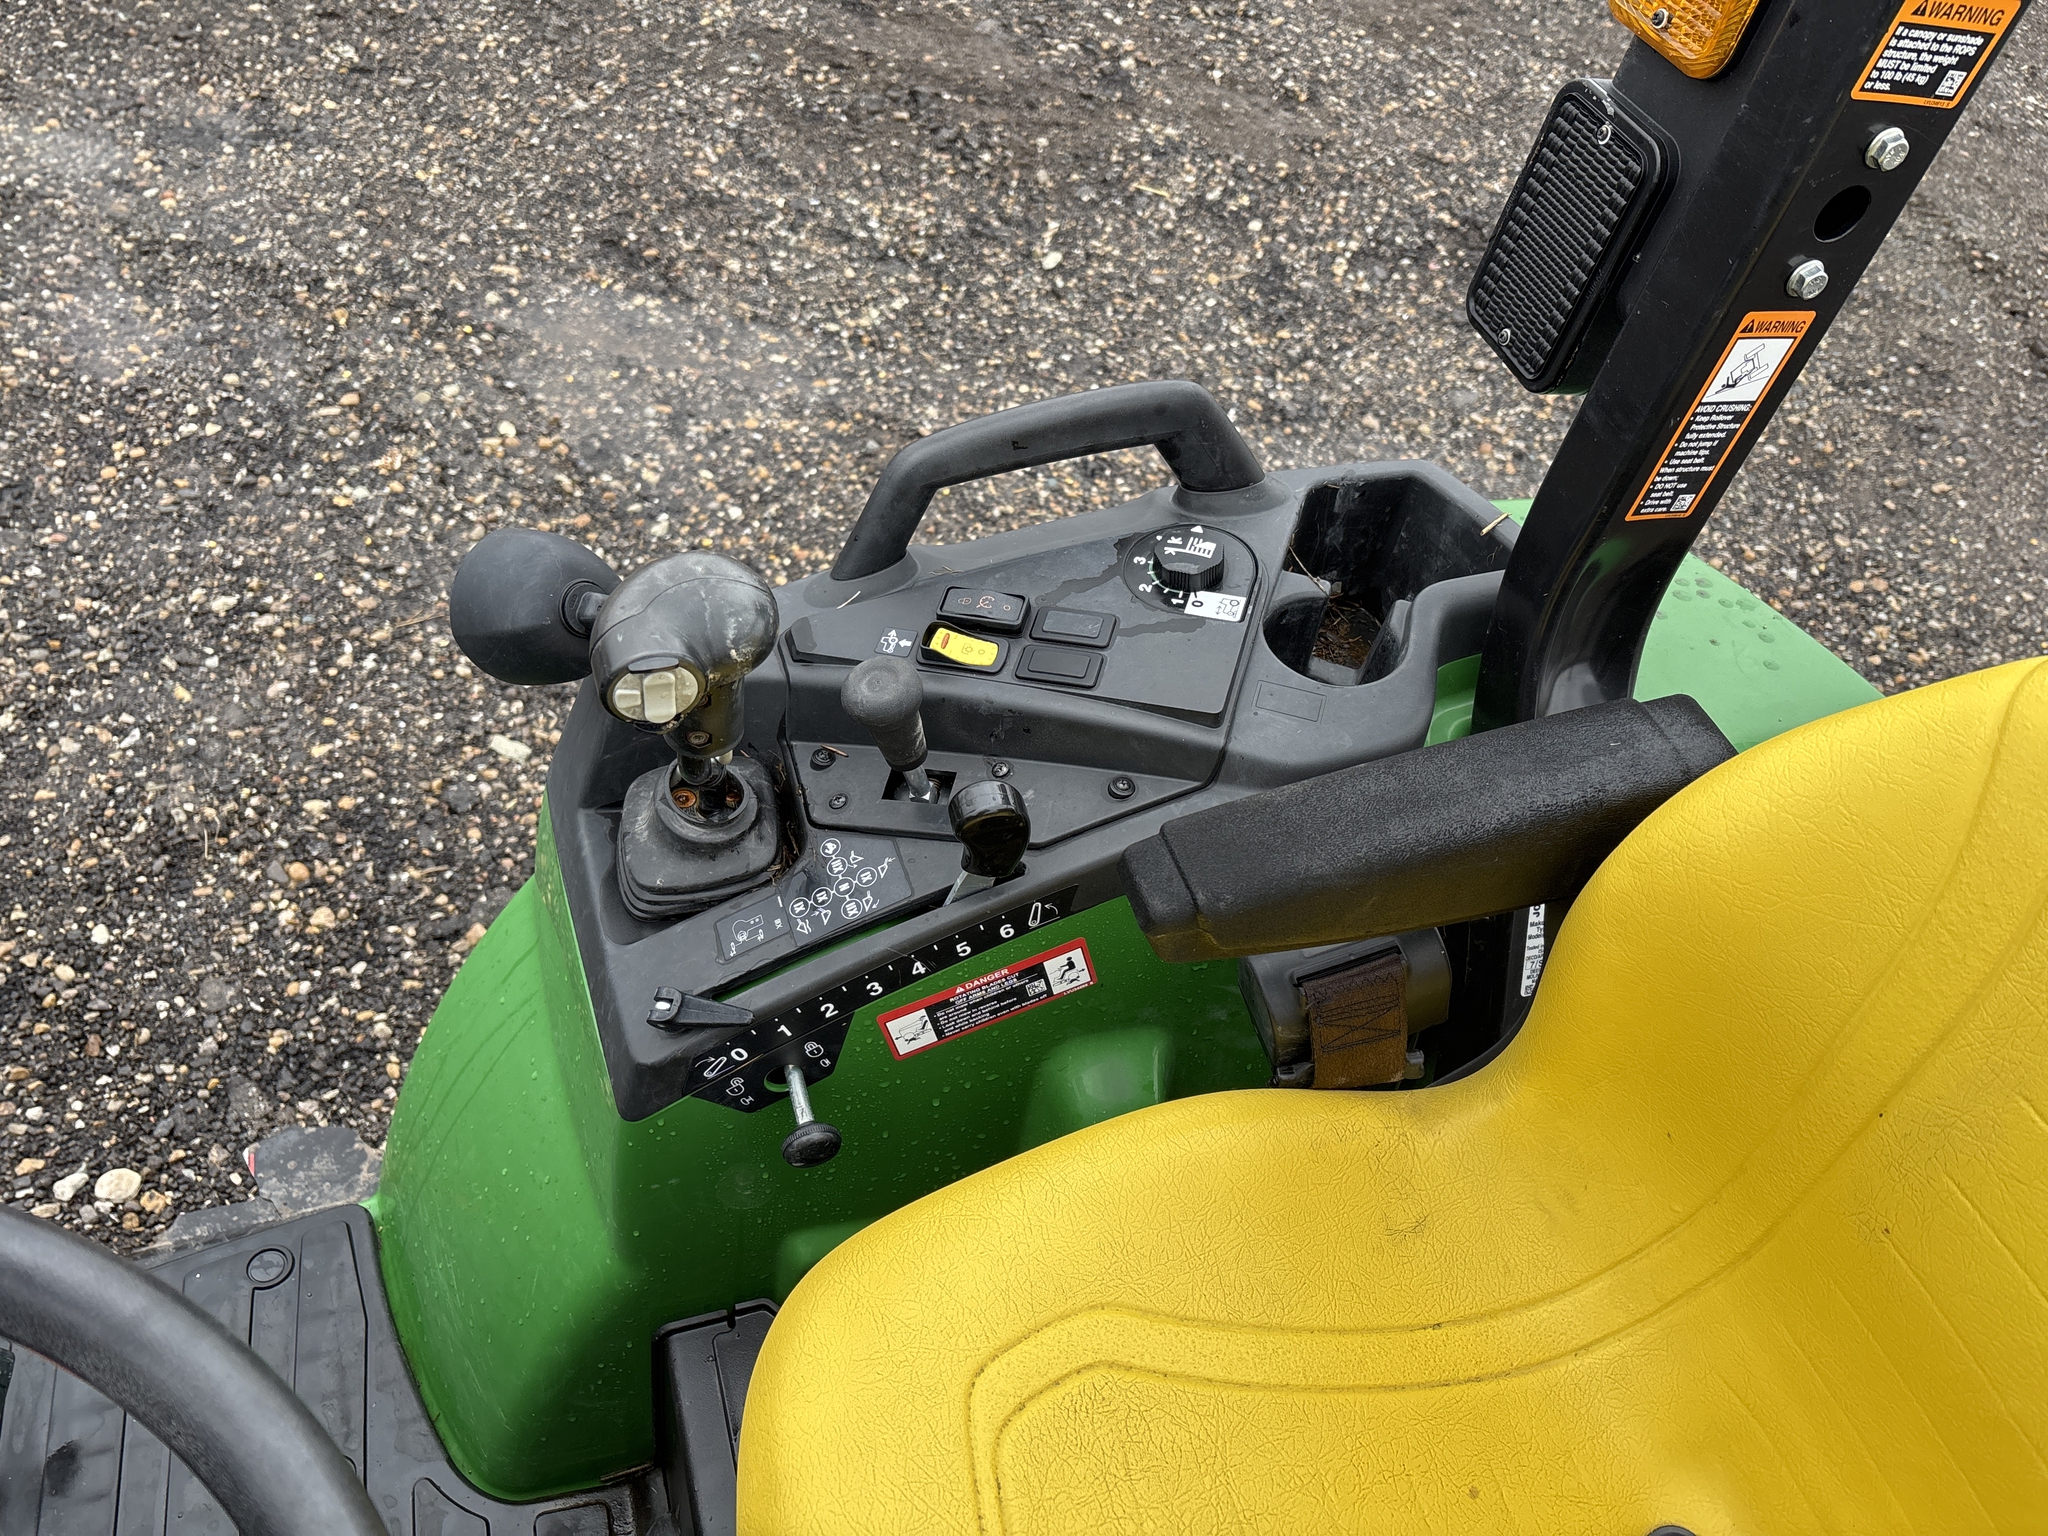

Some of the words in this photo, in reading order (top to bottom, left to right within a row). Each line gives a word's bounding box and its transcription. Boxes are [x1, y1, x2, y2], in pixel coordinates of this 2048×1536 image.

[1928, 0, 2004, 26] WARNING
[1895, 26, 1904, 35] If
[1909, 29, 1938, 41] canopy
[1946, 34, 1984, 46] sunshade
[1889, 37, 1898, 46] is
[1897, 39, 1931, 50] attached
[1930, 42, 1939, 51] to
[1939, 42, 1953, 52] the
[1952, 44, 1977, 56] ROPS
[1876, 59, 1901, 68] MUST
[1899, 60, 1910, 70] be
[1910, 62, 1938, 73] limited
[1882, 49, 1918, 61] structure,
[1919, 52, 1933, 62] the
[1933, 55, 1959, 66] weight
[1870, 70, 1879, 79] to
[1881, 71, 1894, 80] 100
[1894, 71, 1902, 80] lb
[1901, 73, 1916, 83] (45
[1915, 74, 1930, 85] kg)
[1873, 81, 1890, 90] less.
[1754, 320, 1806, 333] WARNING
[1133, 556, 1146, 565] 3
[1139, 584, 1153, 592] 2
[965, 969, 1009, 989] DANGER
[730, 1048, 748, 1061] 0
[777, 1025, 793, 1037] 1
[820, 1003, 838, 1018] 2
[866, 982, 883, 996] 3
[912, 961, 926, 975] 4
[956, 941, 971, 957] 5
[1000, 924, 1015, 938] 6
[950, 988, 980, 1002] ROTATING
[982, 978, 1006, 990] BLADES
[969, 991, 986, 999] ARMS
[987, 984, 1000, 993] AND
[1001, 978, 1017, 986] LEGS
